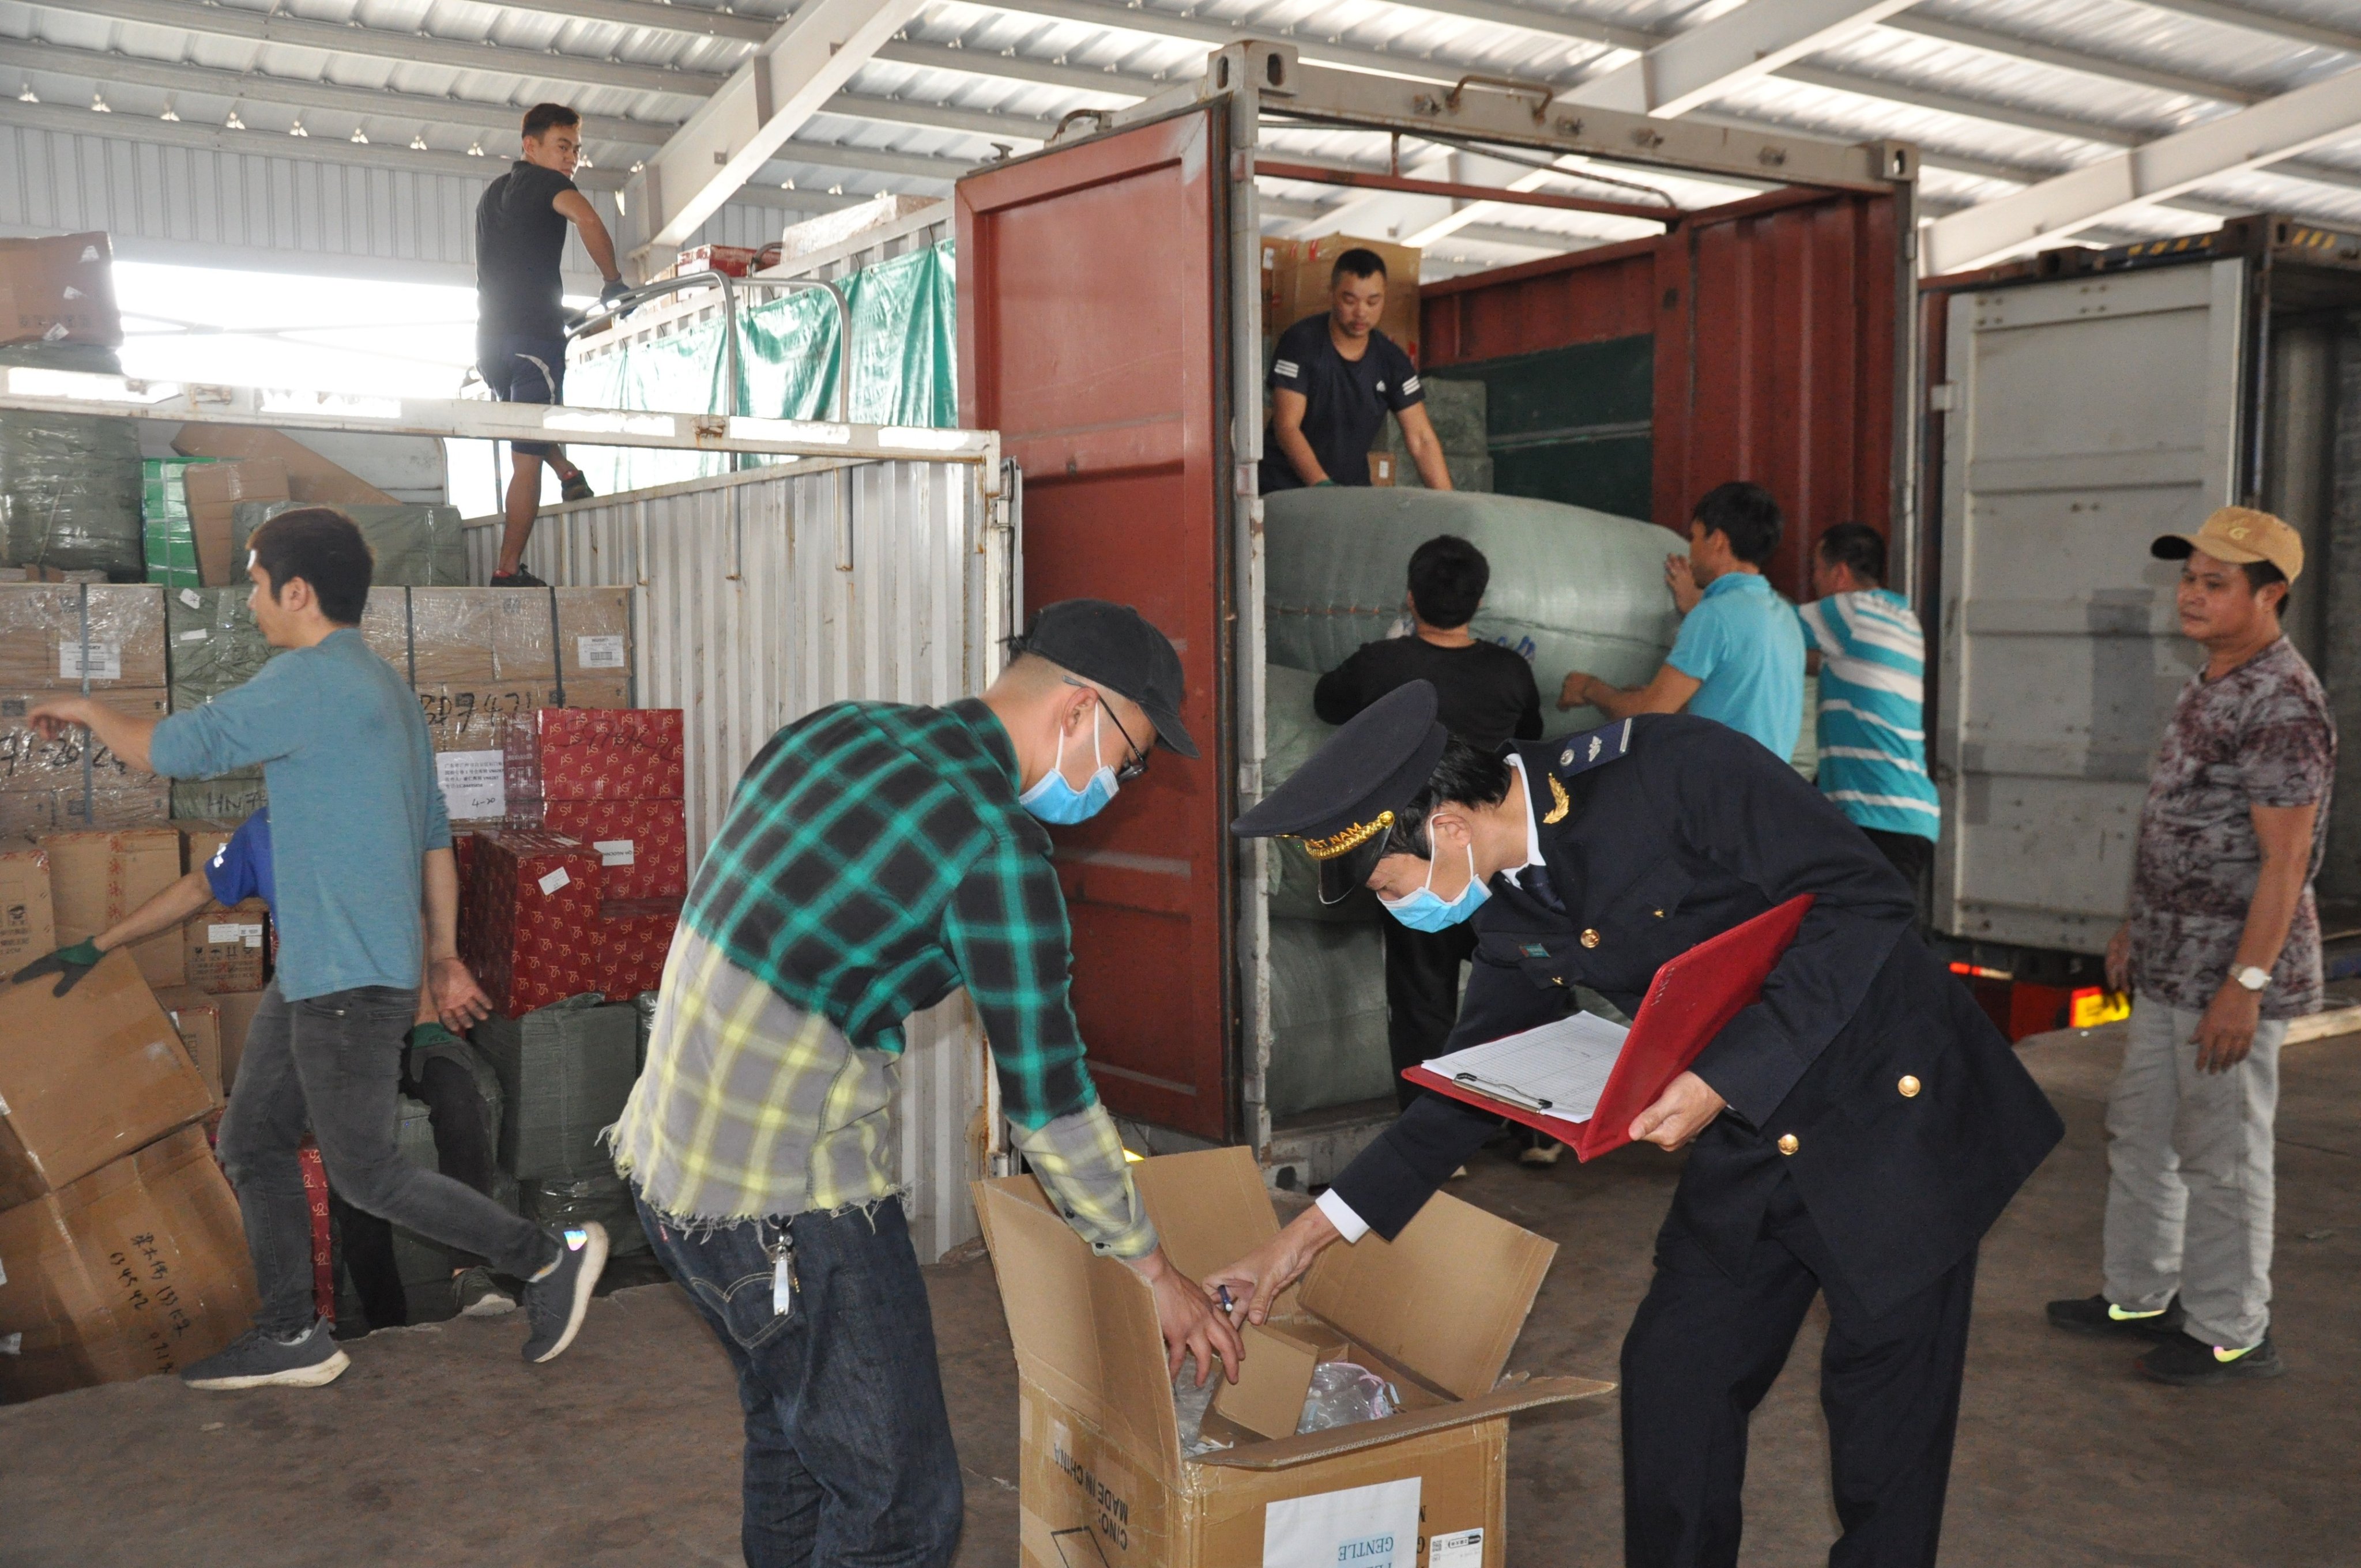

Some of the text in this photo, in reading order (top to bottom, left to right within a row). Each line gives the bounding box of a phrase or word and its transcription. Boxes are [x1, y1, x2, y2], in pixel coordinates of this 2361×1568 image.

[1328, 822, 1362, 844] NAM
[1054, 1443, 1128, 1525] MADE IN CHINA
[1338, 1536, 1394, 1561] GENTLE
